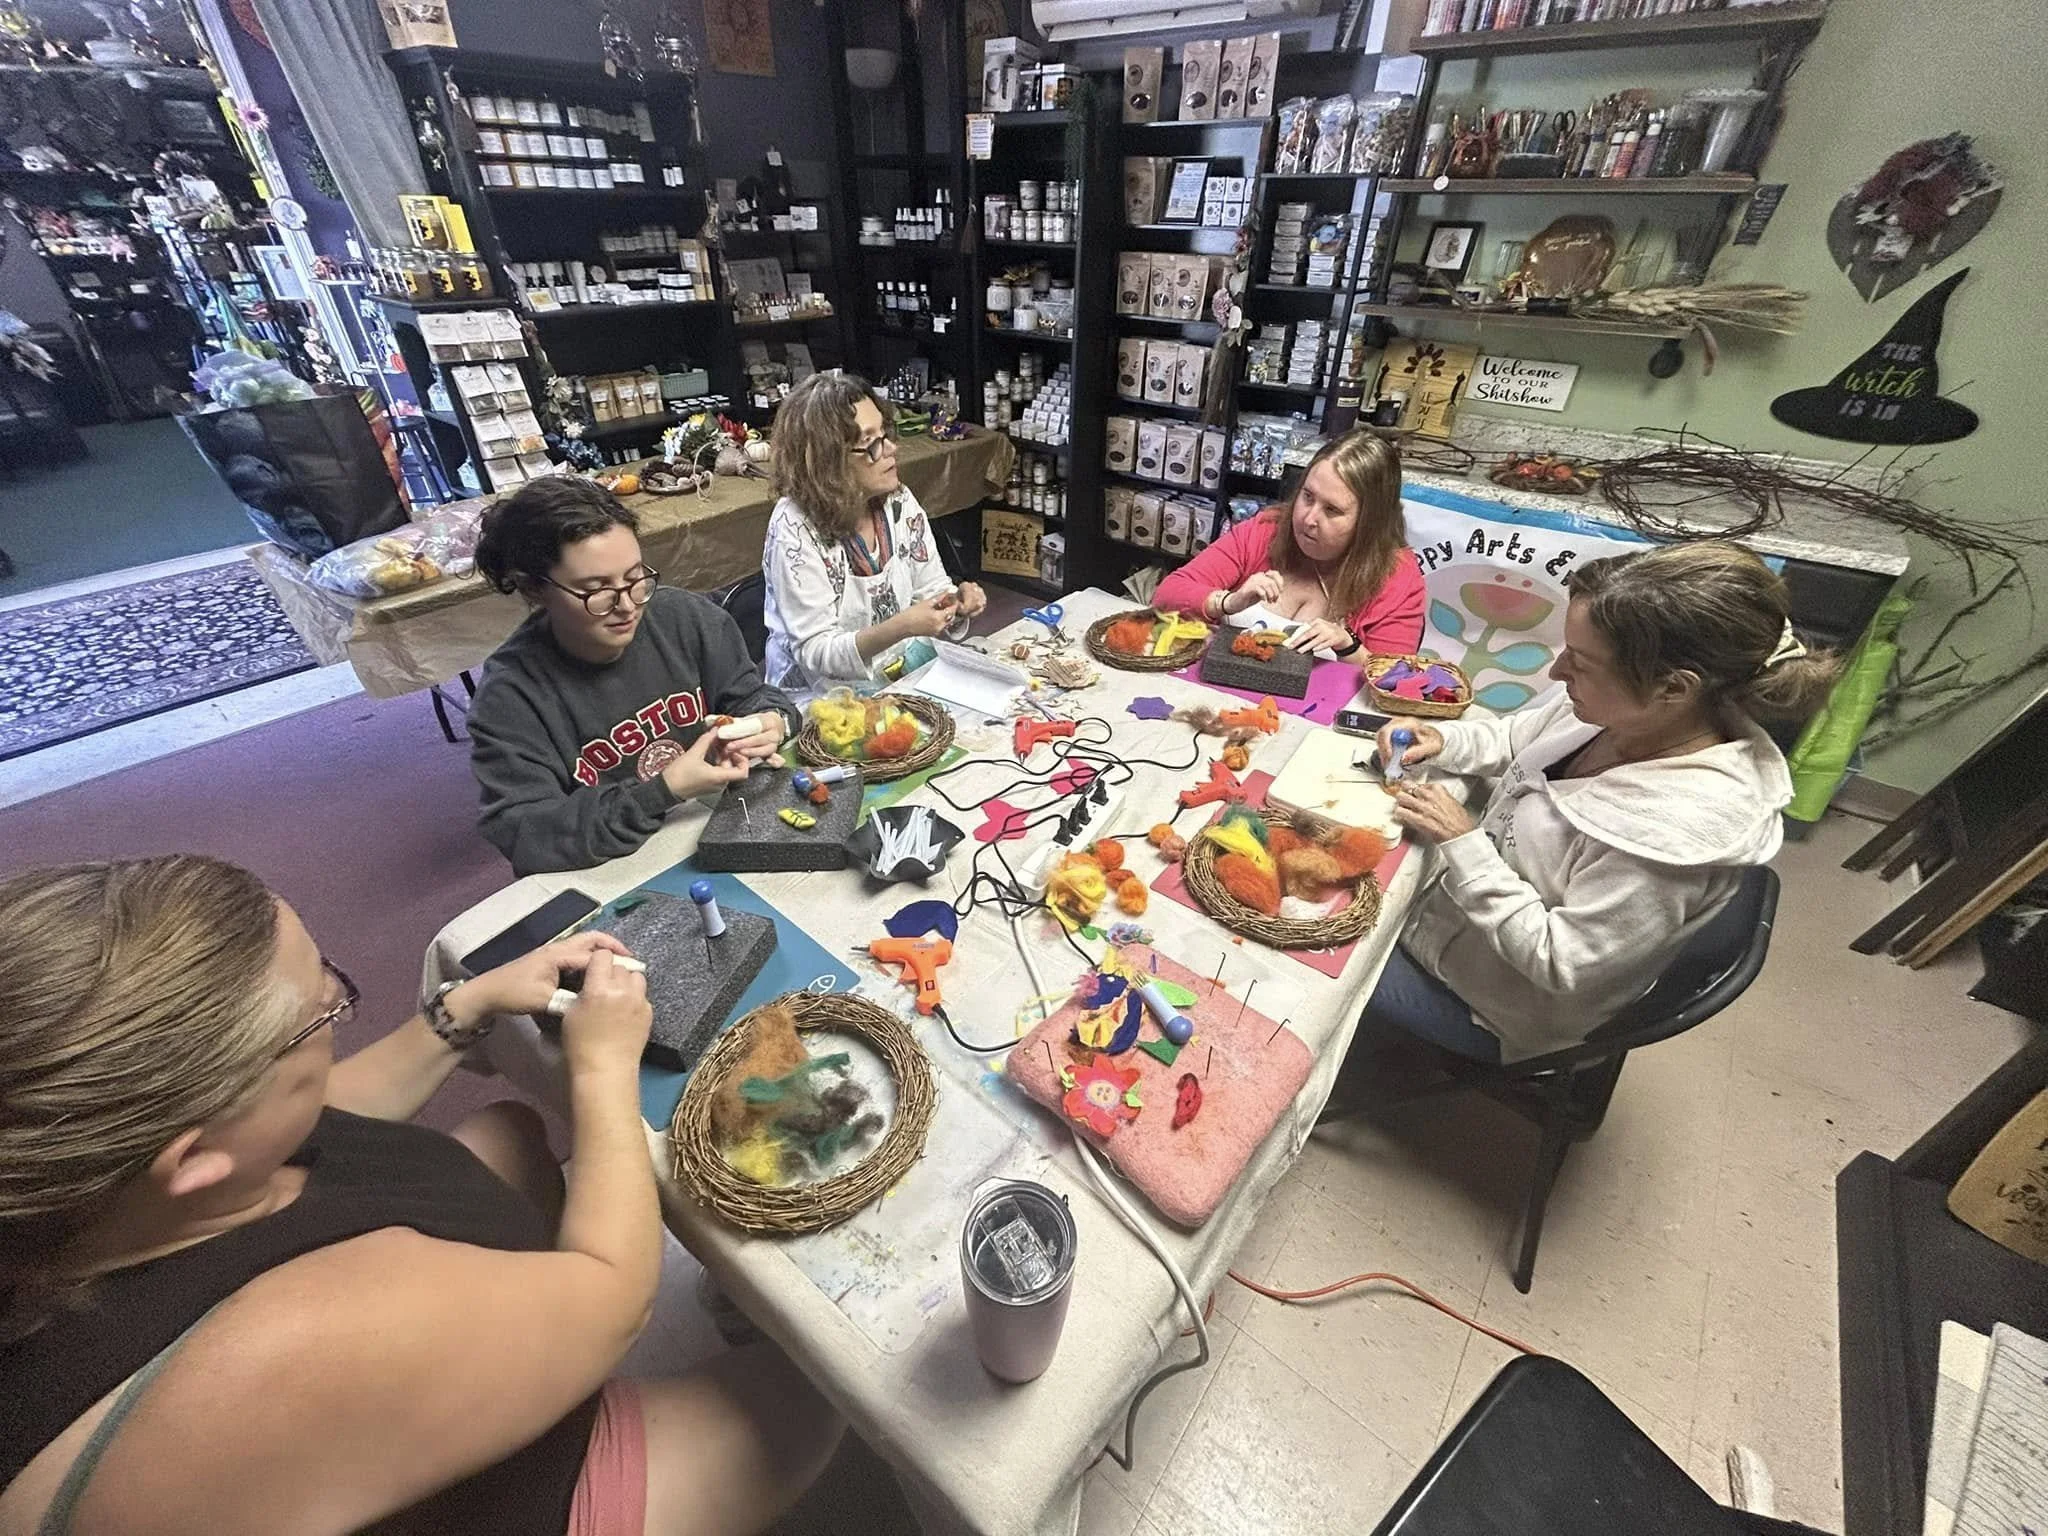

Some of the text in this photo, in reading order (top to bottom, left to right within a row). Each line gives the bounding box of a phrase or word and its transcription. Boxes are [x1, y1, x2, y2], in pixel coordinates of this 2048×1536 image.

[1483, 358, 1563, 379] Welcome
[1492, 375, 1549, 388] TO OUR
[1844, 365, 1926, 398] witch
[1474, 383, 1553, 404] Shitshow
[1415, 540, 1453, 576] ppy
[1466, 528, 1536, 564] Arts
